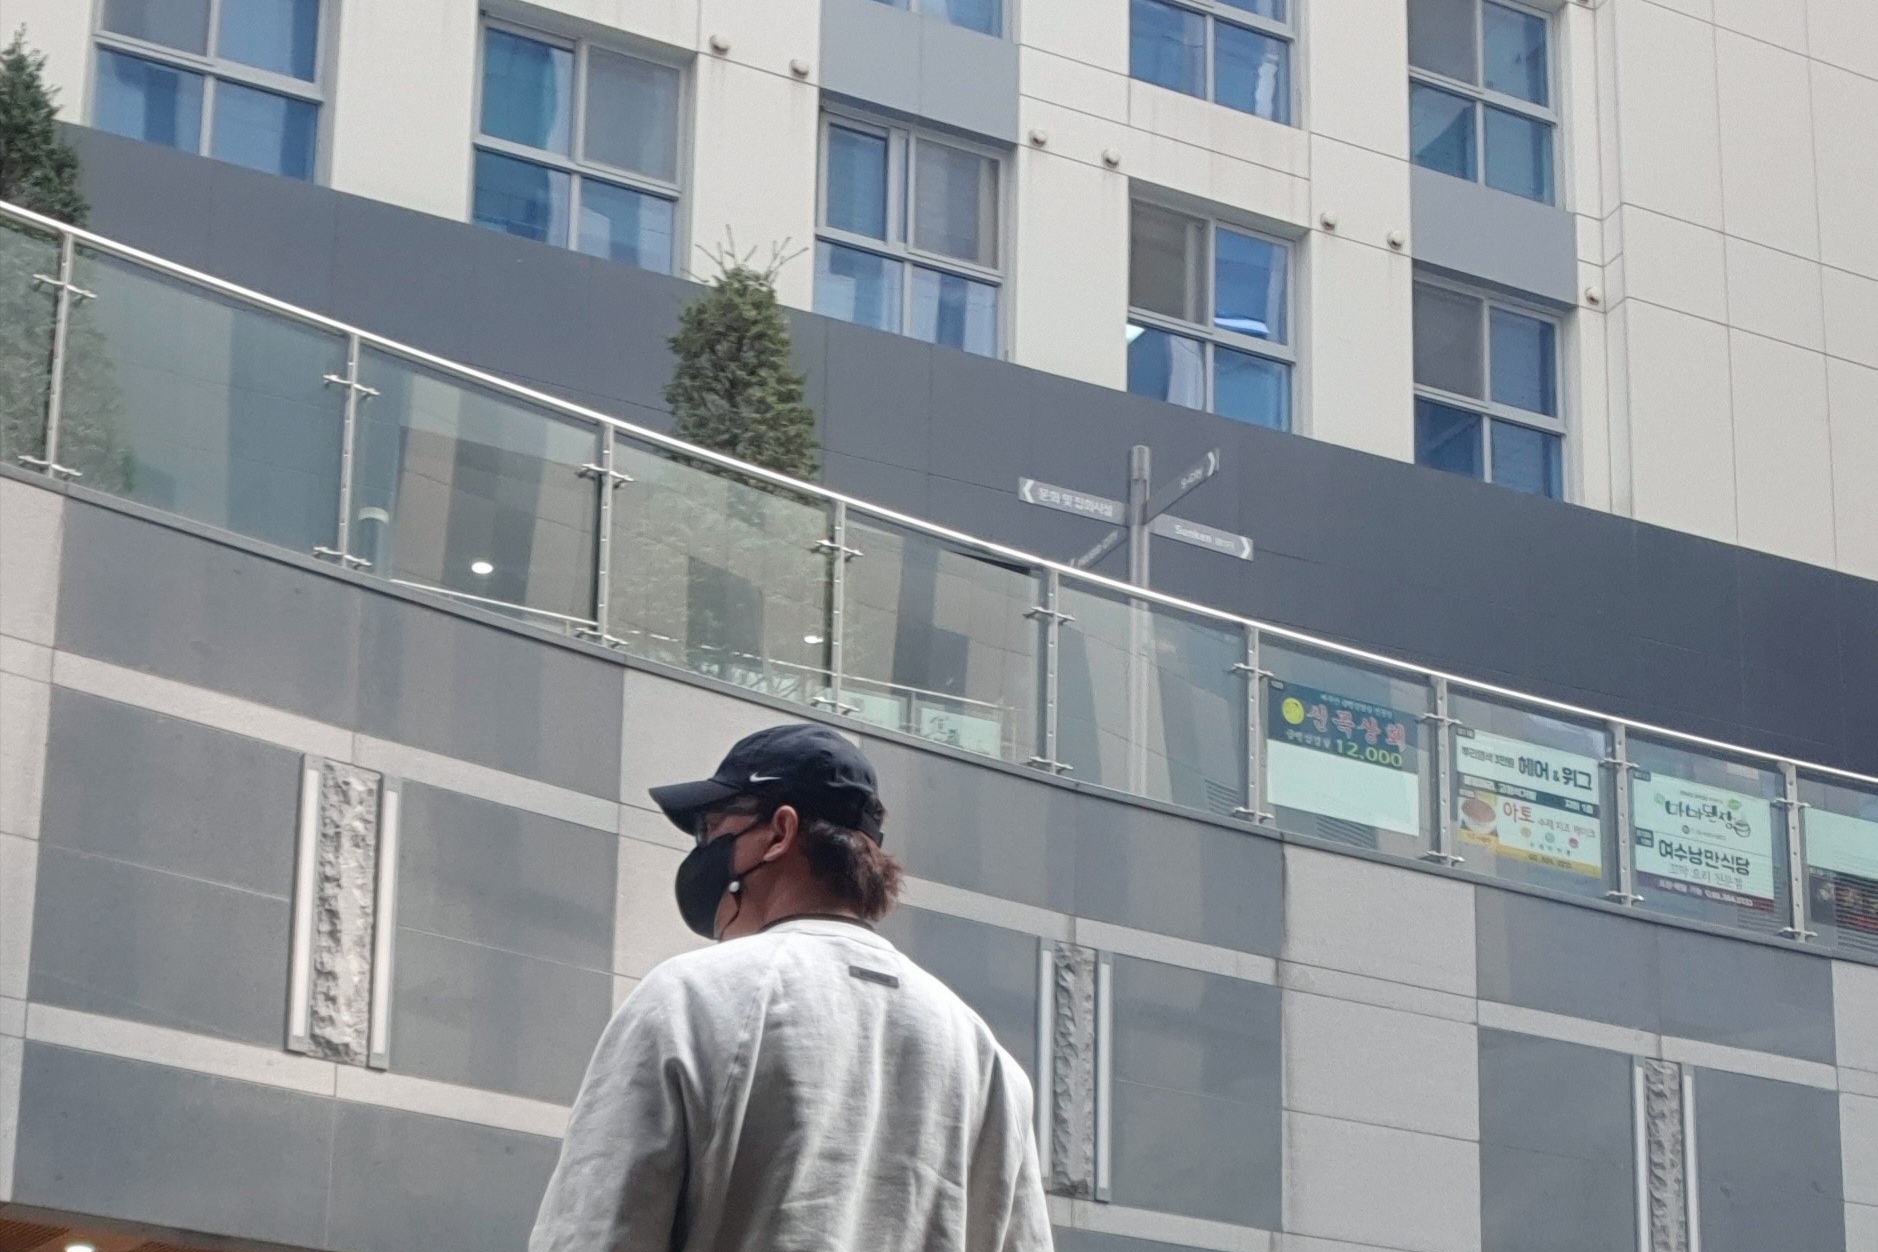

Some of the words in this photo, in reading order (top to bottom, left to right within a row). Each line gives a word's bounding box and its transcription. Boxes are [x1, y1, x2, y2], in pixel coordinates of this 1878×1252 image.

[1518, 756, 1549, 781] 헤어
[1562, 767, 1592, 791] 위그
[1503, 801, 1535, 823] 아토
[1658, 839, 1750, 876] 여수낭만식당
